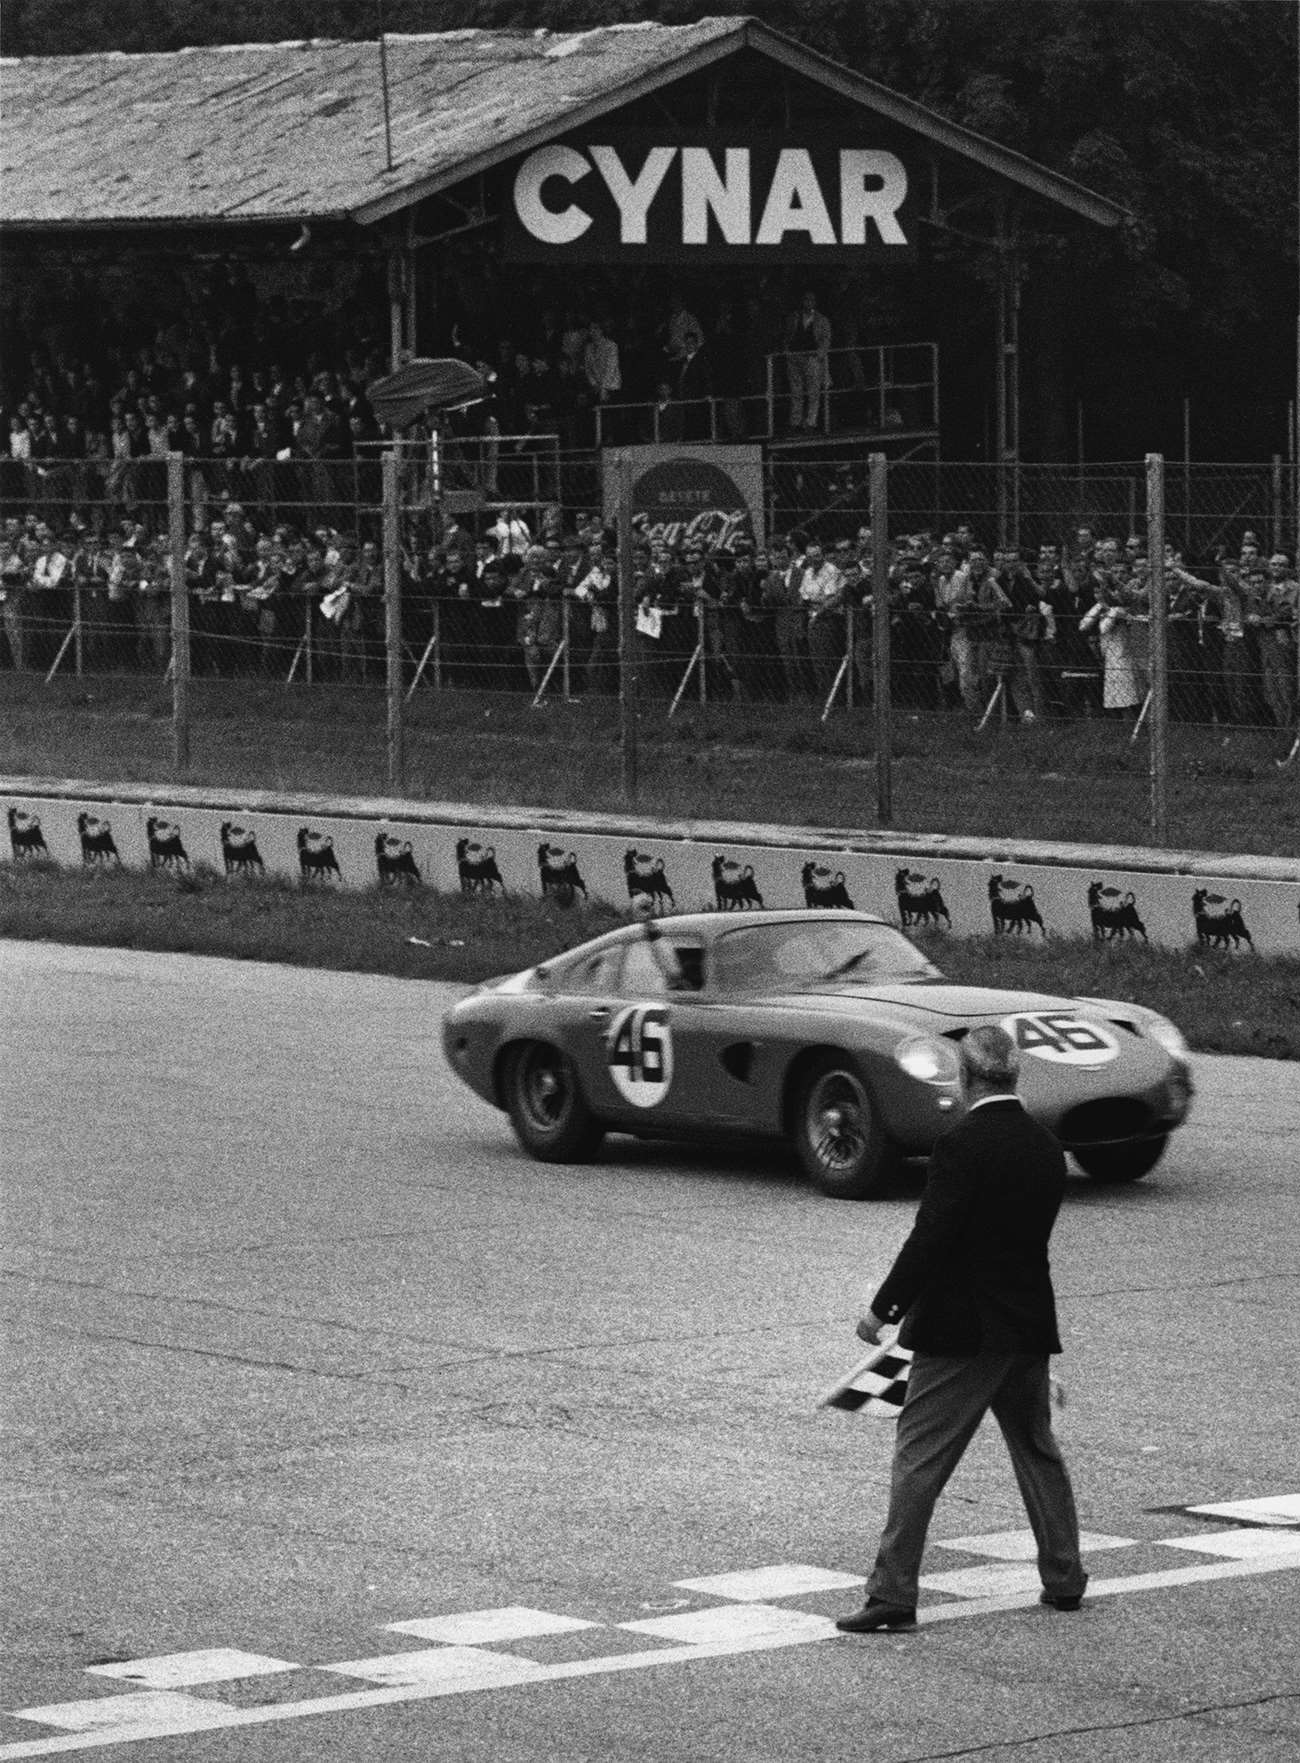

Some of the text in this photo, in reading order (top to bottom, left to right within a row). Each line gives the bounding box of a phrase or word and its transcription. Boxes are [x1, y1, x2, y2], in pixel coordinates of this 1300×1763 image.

[513, 144, 908, 245] CYNAR
[611, 1008, 669, 1083] 46
[1015, 1014, 1111, 1054] 46
